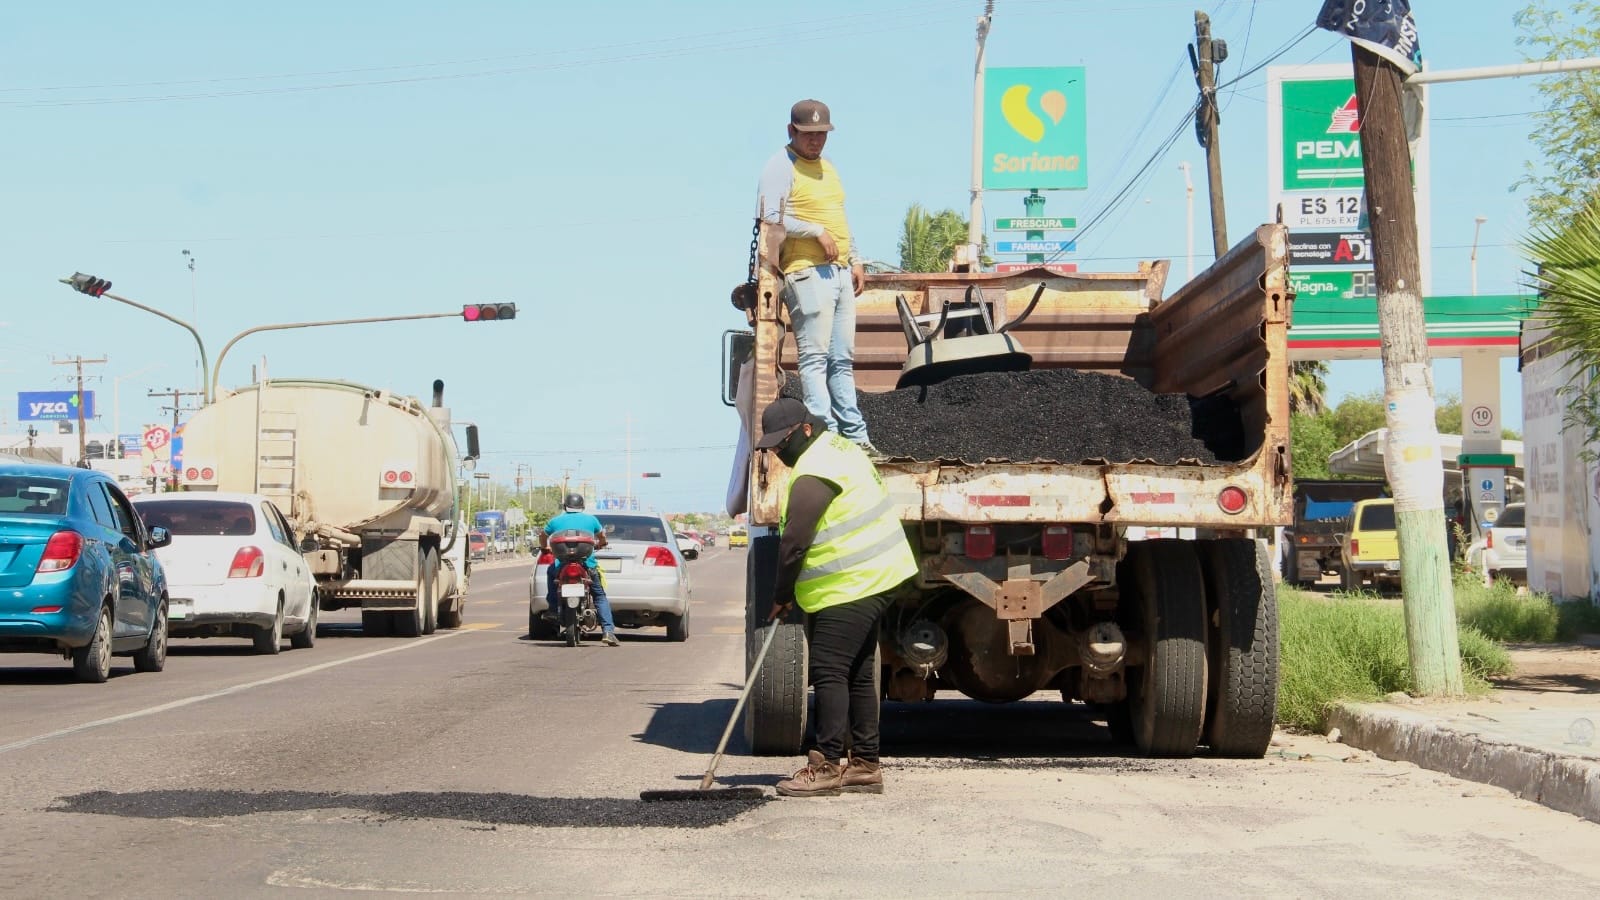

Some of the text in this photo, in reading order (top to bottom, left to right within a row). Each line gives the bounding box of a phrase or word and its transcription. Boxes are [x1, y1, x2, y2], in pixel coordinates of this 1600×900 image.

[1296, 140, 1360, 160] PEM
[992, 151, 1080, 174] Soriana
[1301, 196, 1359, 215] ES 12
[1010, 219, 1063, 228] FRESCURA
[1300, 217, 1312, 225] PL
[1011, 242, 1061, 252] FARMACIA
[1333, 239, 1372, 262] ADi
[29, 402, 69, 417] yza
[1475, 410, 1489, 420] 10
